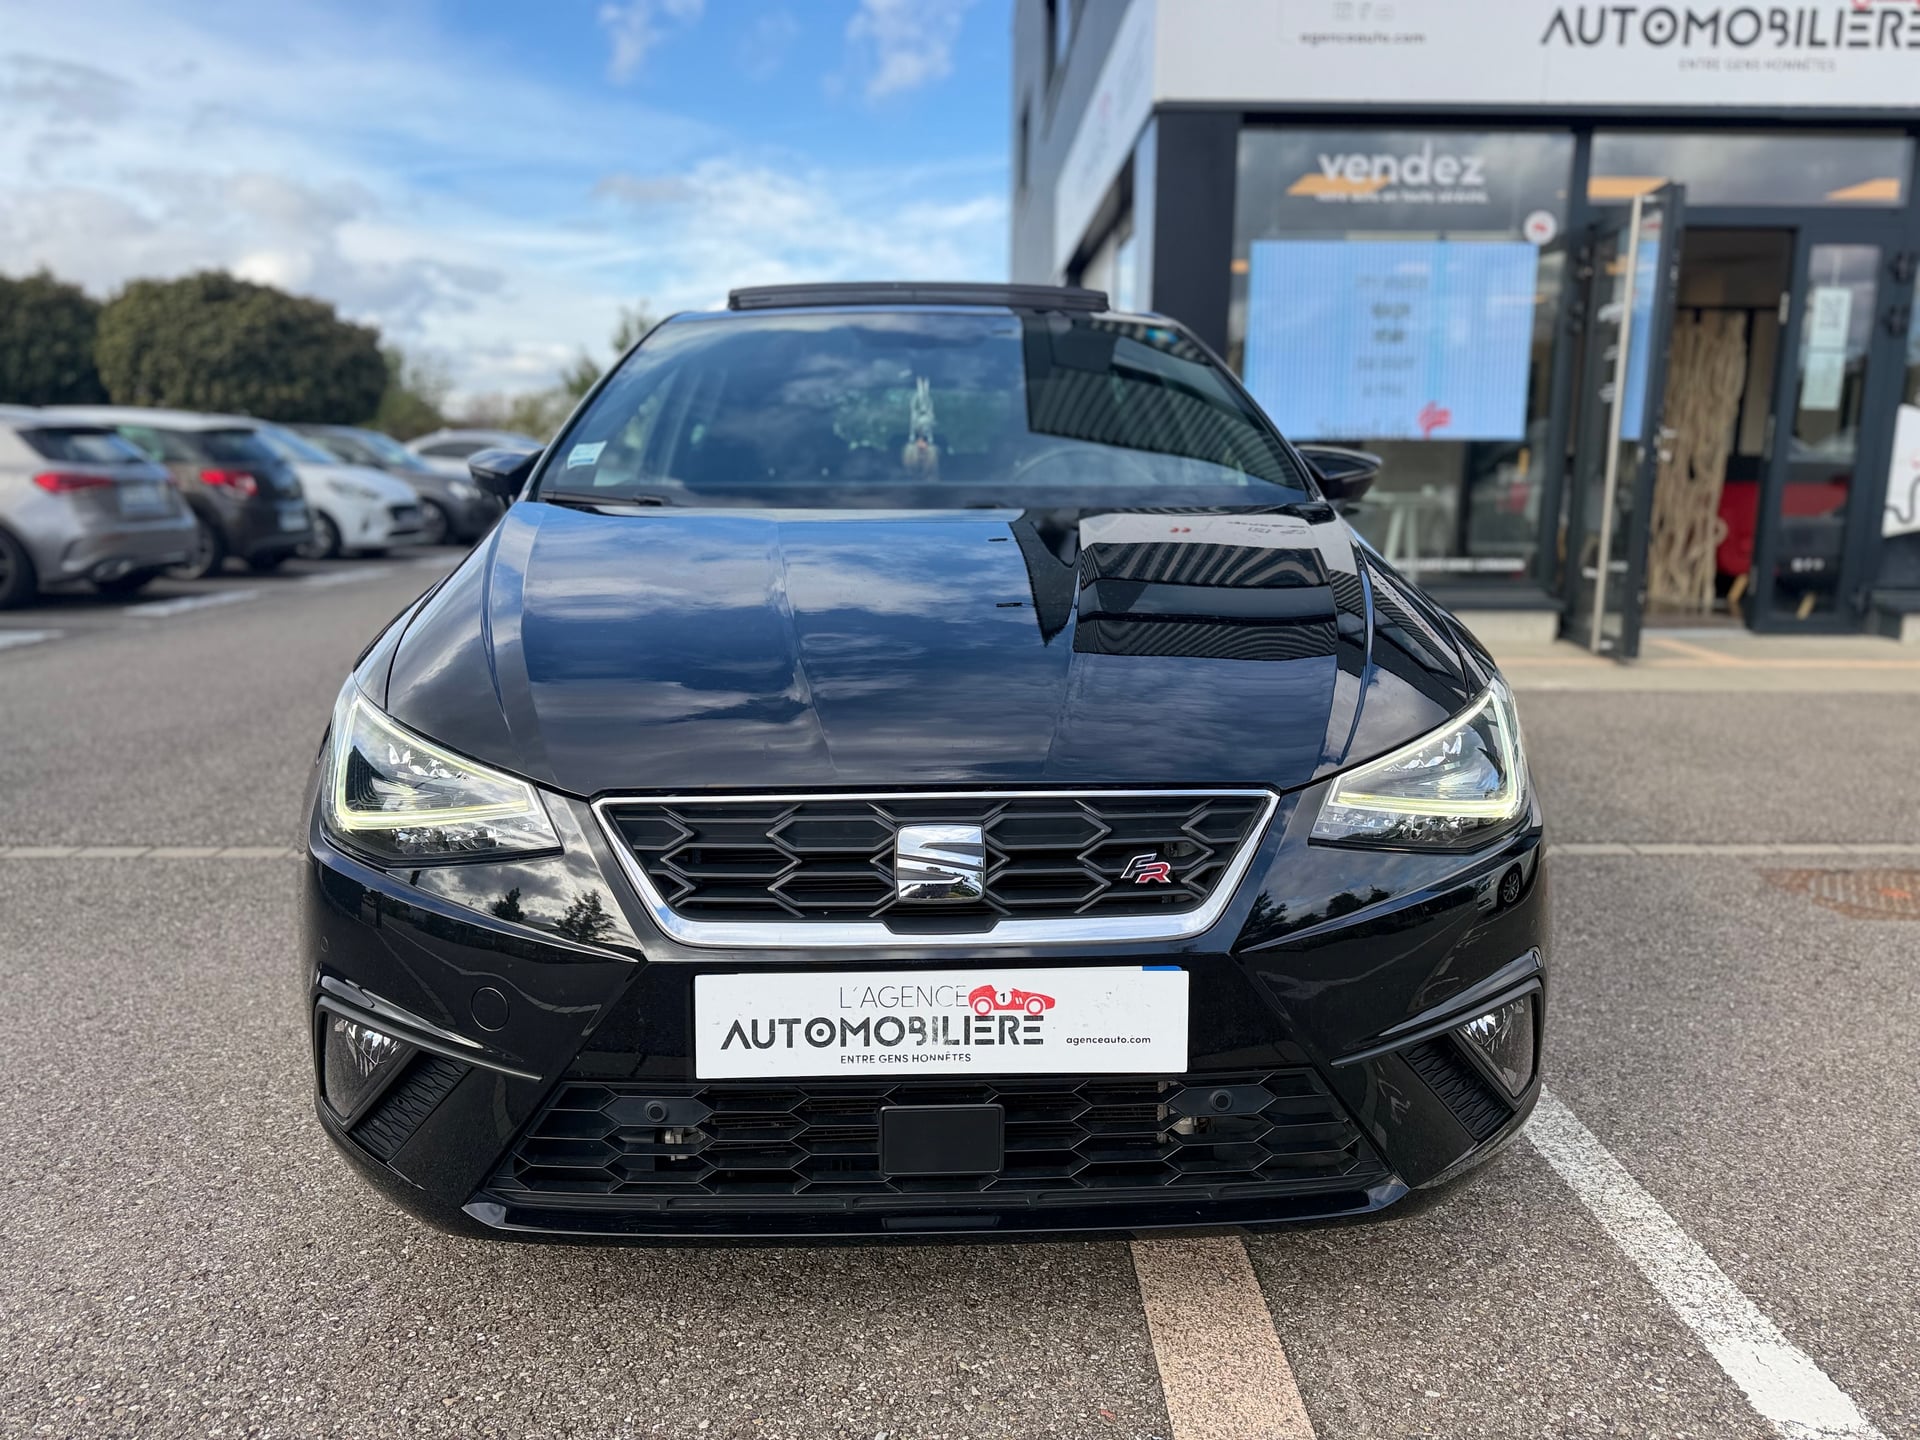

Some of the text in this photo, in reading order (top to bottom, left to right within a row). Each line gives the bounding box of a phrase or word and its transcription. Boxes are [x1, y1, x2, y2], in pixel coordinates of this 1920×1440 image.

[1317, 142, 1485, 186] vendez
[1120, 852, 1171, 884] FR
[839, 985, 969, 1009] L'AGENCE
[1000, 992, 1006, 1003] 1
[1066, 1036, 1151, 1046] agenceauto.com
[840, 1055, 876, 1064] ENTRE
[878, 1053, 909, 1064] GENS
